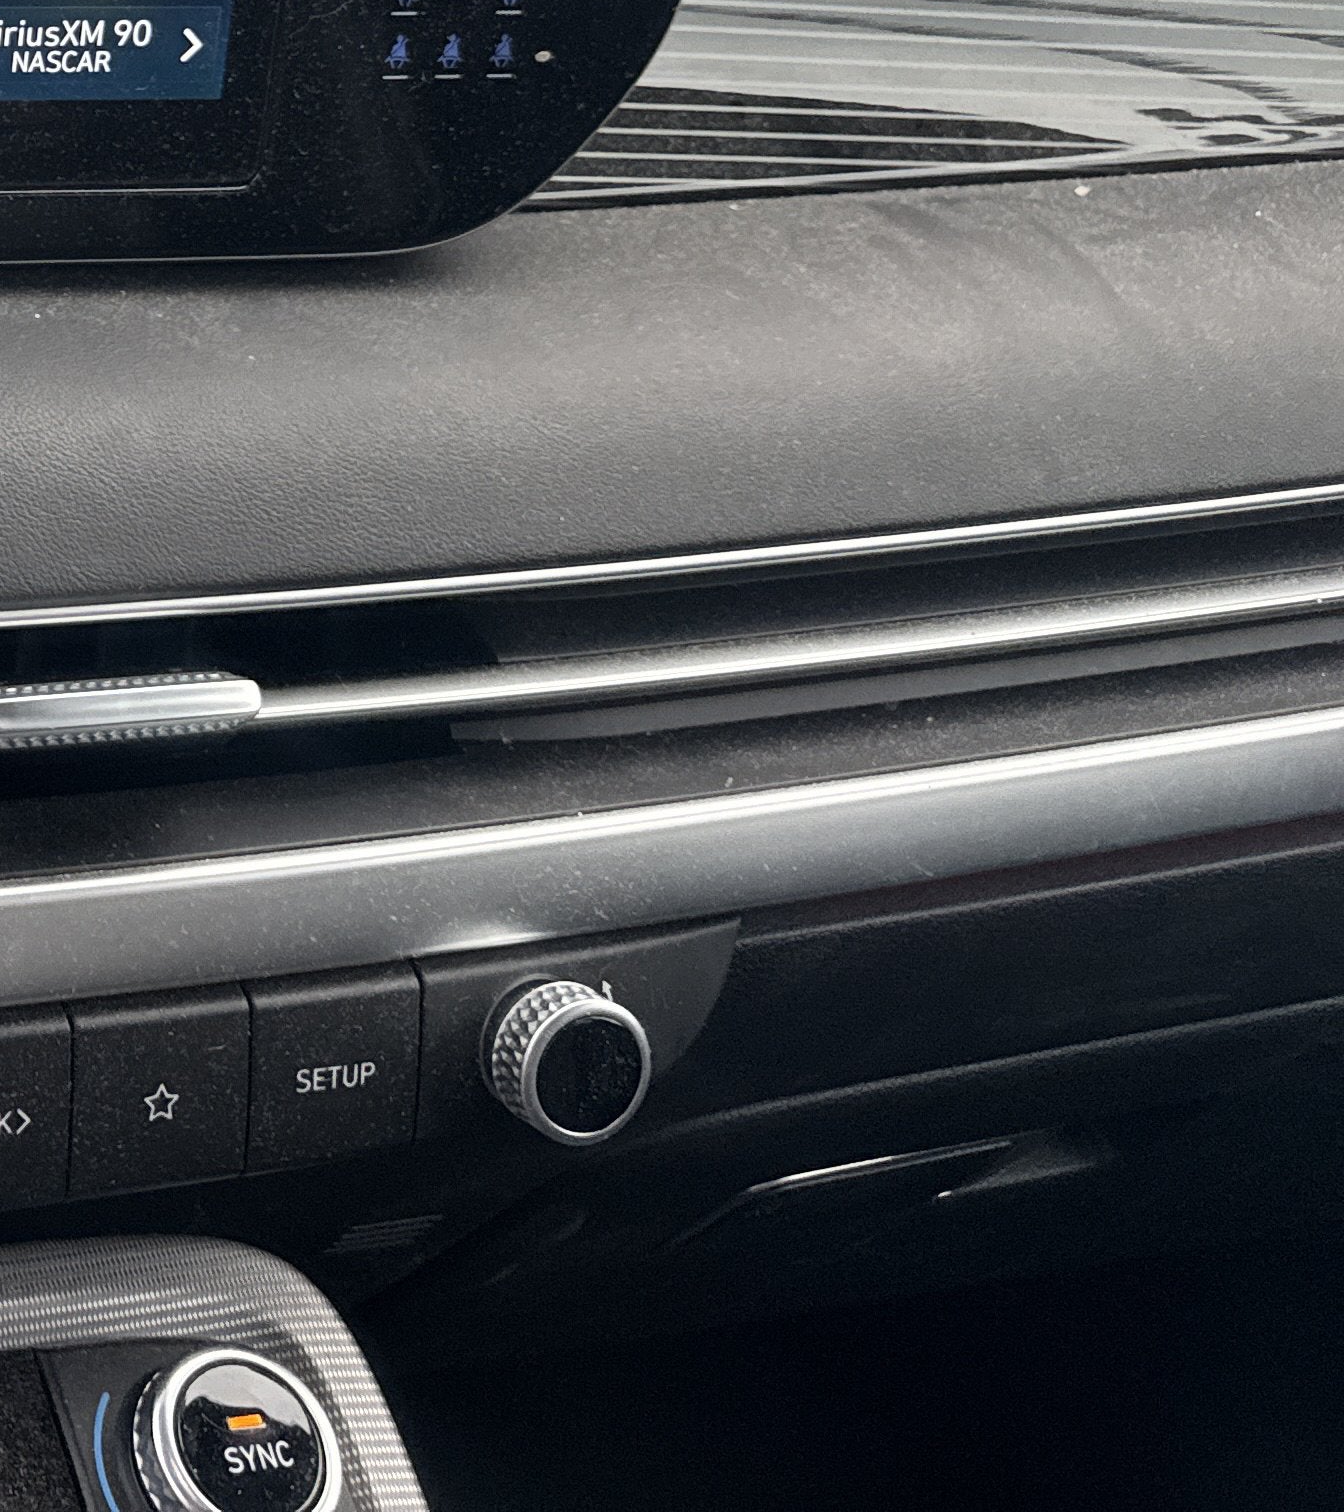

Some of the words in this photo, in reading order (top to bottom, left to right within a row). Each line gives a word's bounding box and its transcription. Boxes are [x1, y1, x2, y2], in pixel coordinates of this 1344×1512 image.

[114, 20, 151, 46] 90
[12, 51, 110, 73] NASCAR
[296, 1061, 376, 1093] SETUP
[224, 1440, 295, 1474] SYNC
